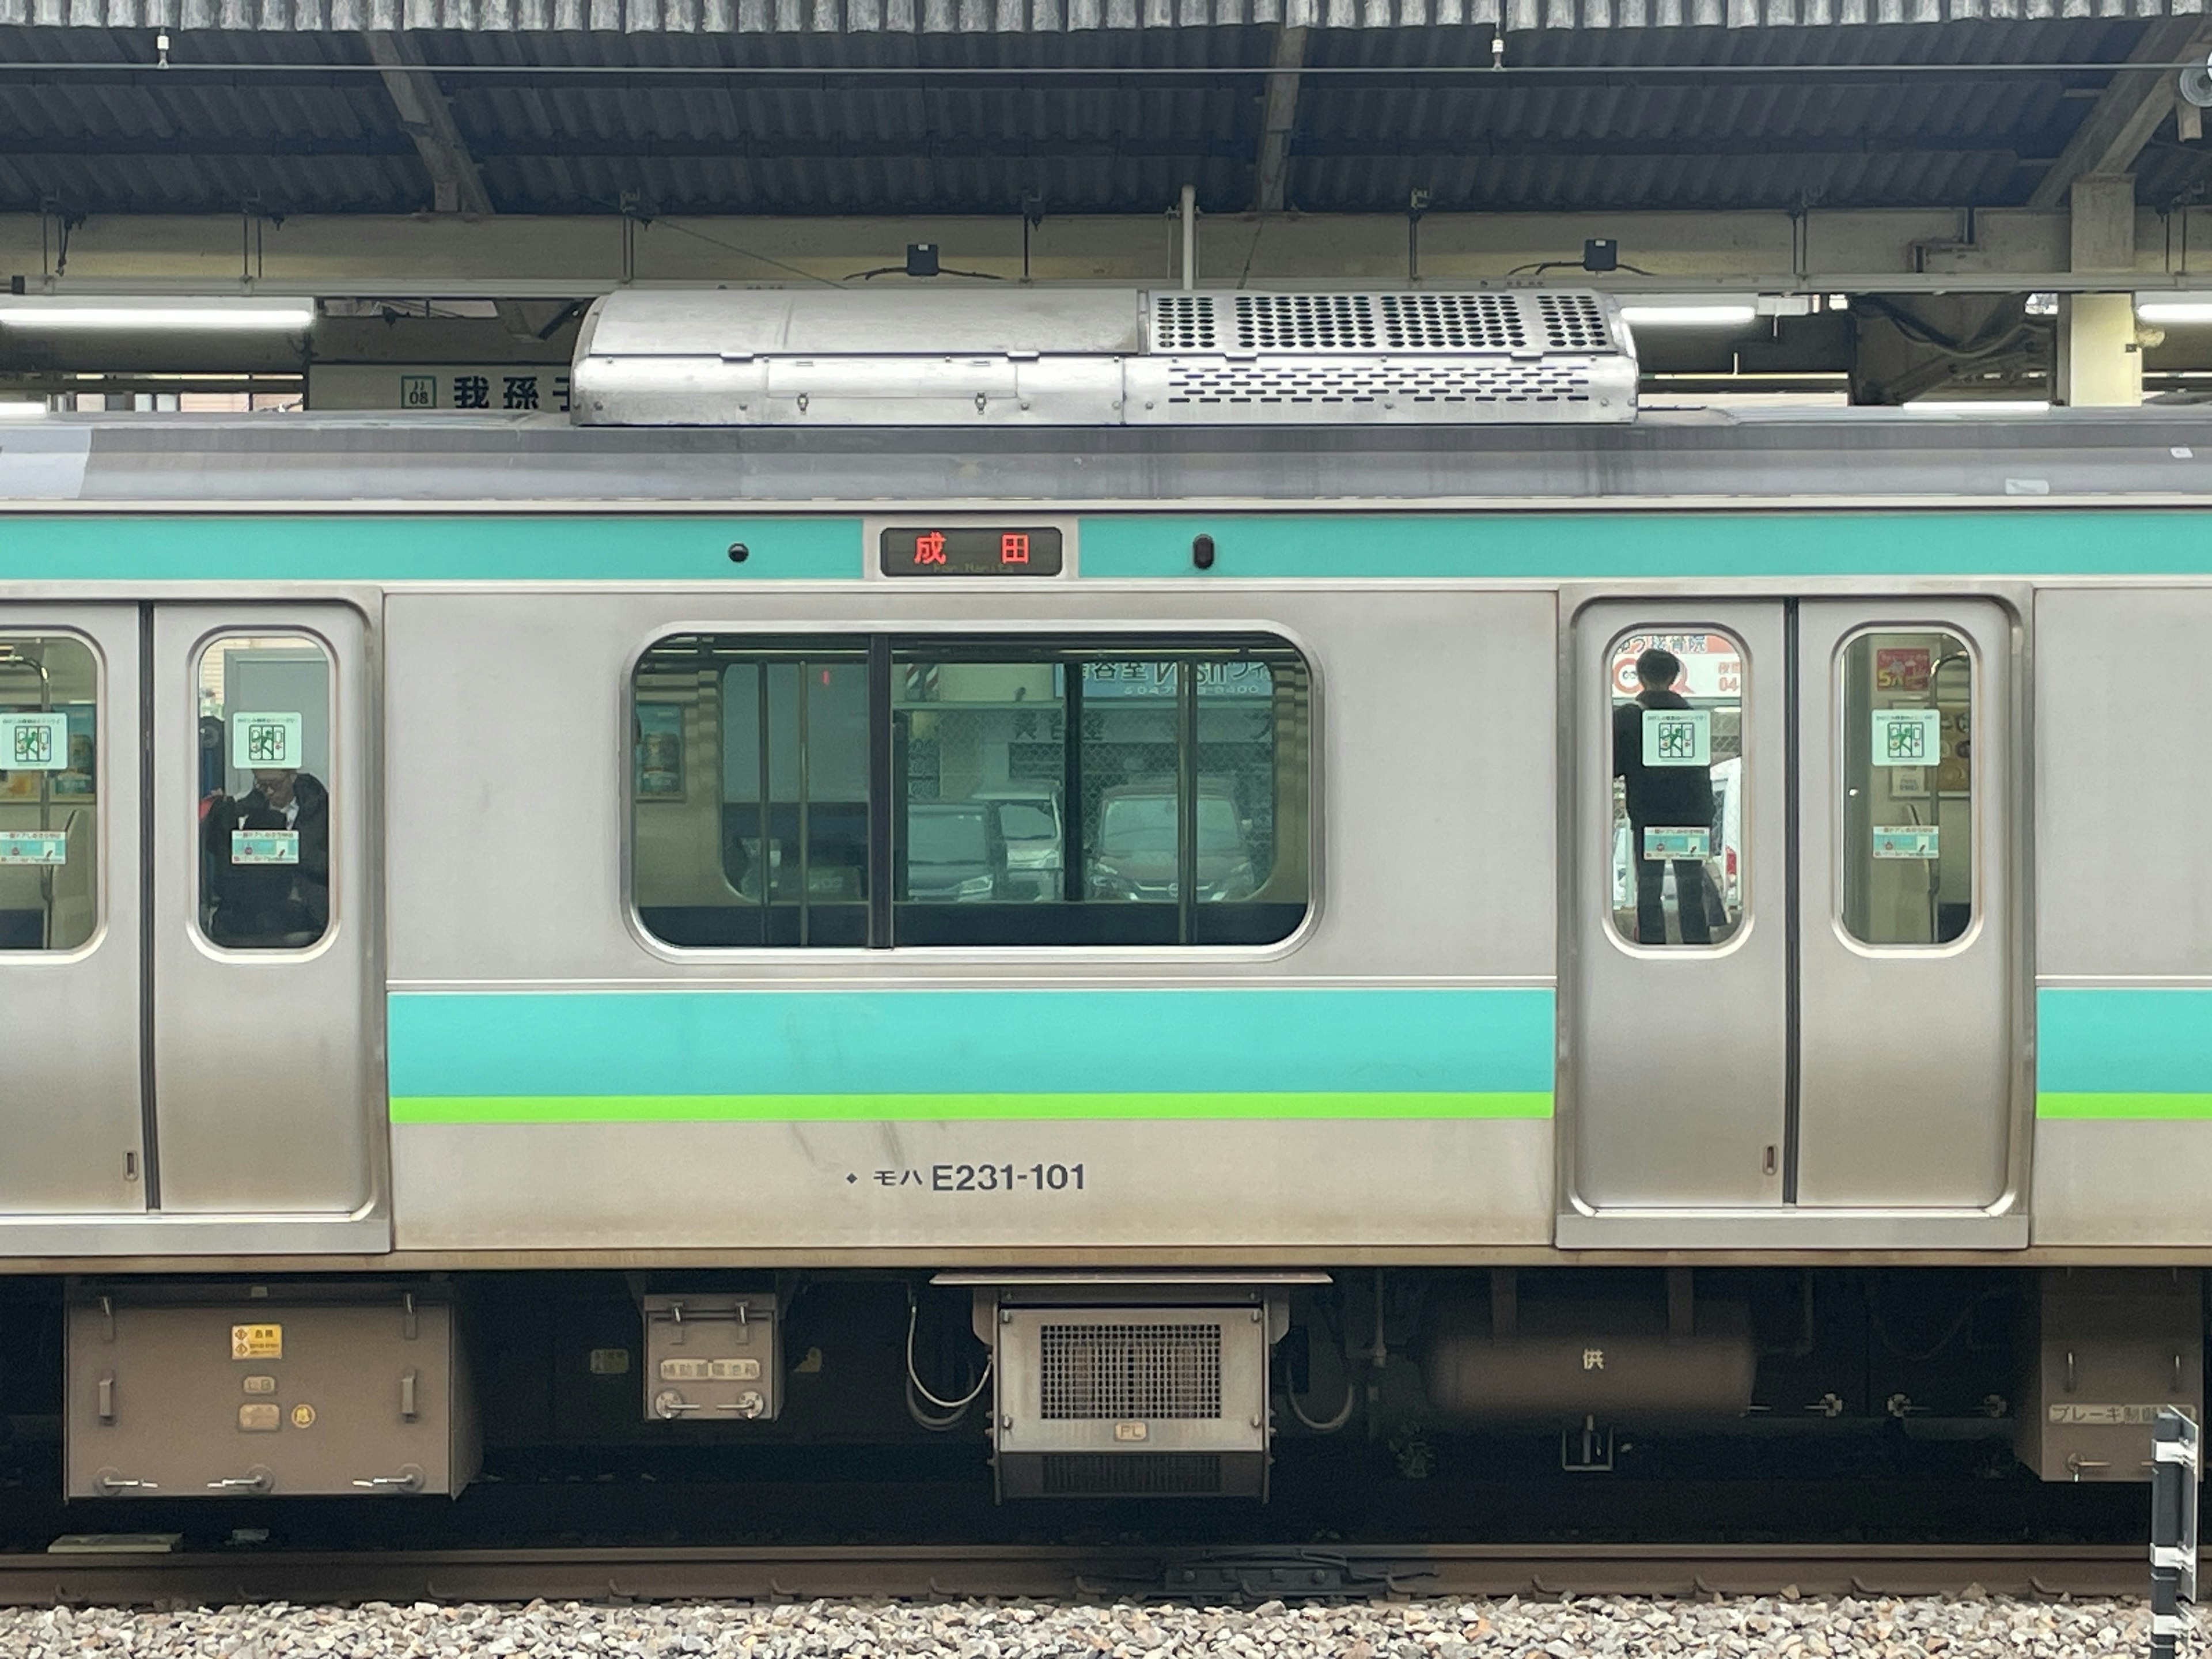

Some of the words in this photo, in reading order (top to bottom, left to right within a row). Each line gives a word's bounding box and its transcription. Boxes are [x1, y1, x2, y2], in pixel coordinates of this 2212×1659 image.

[409, 392, 429, 405] 08
[914, 531, 1030, 565] 成田
[873, 1169, 923, 1187] モハ
[932, 1164, 1085, 1191] E231-101
[1582, 1348, 1605, 1370] 供
